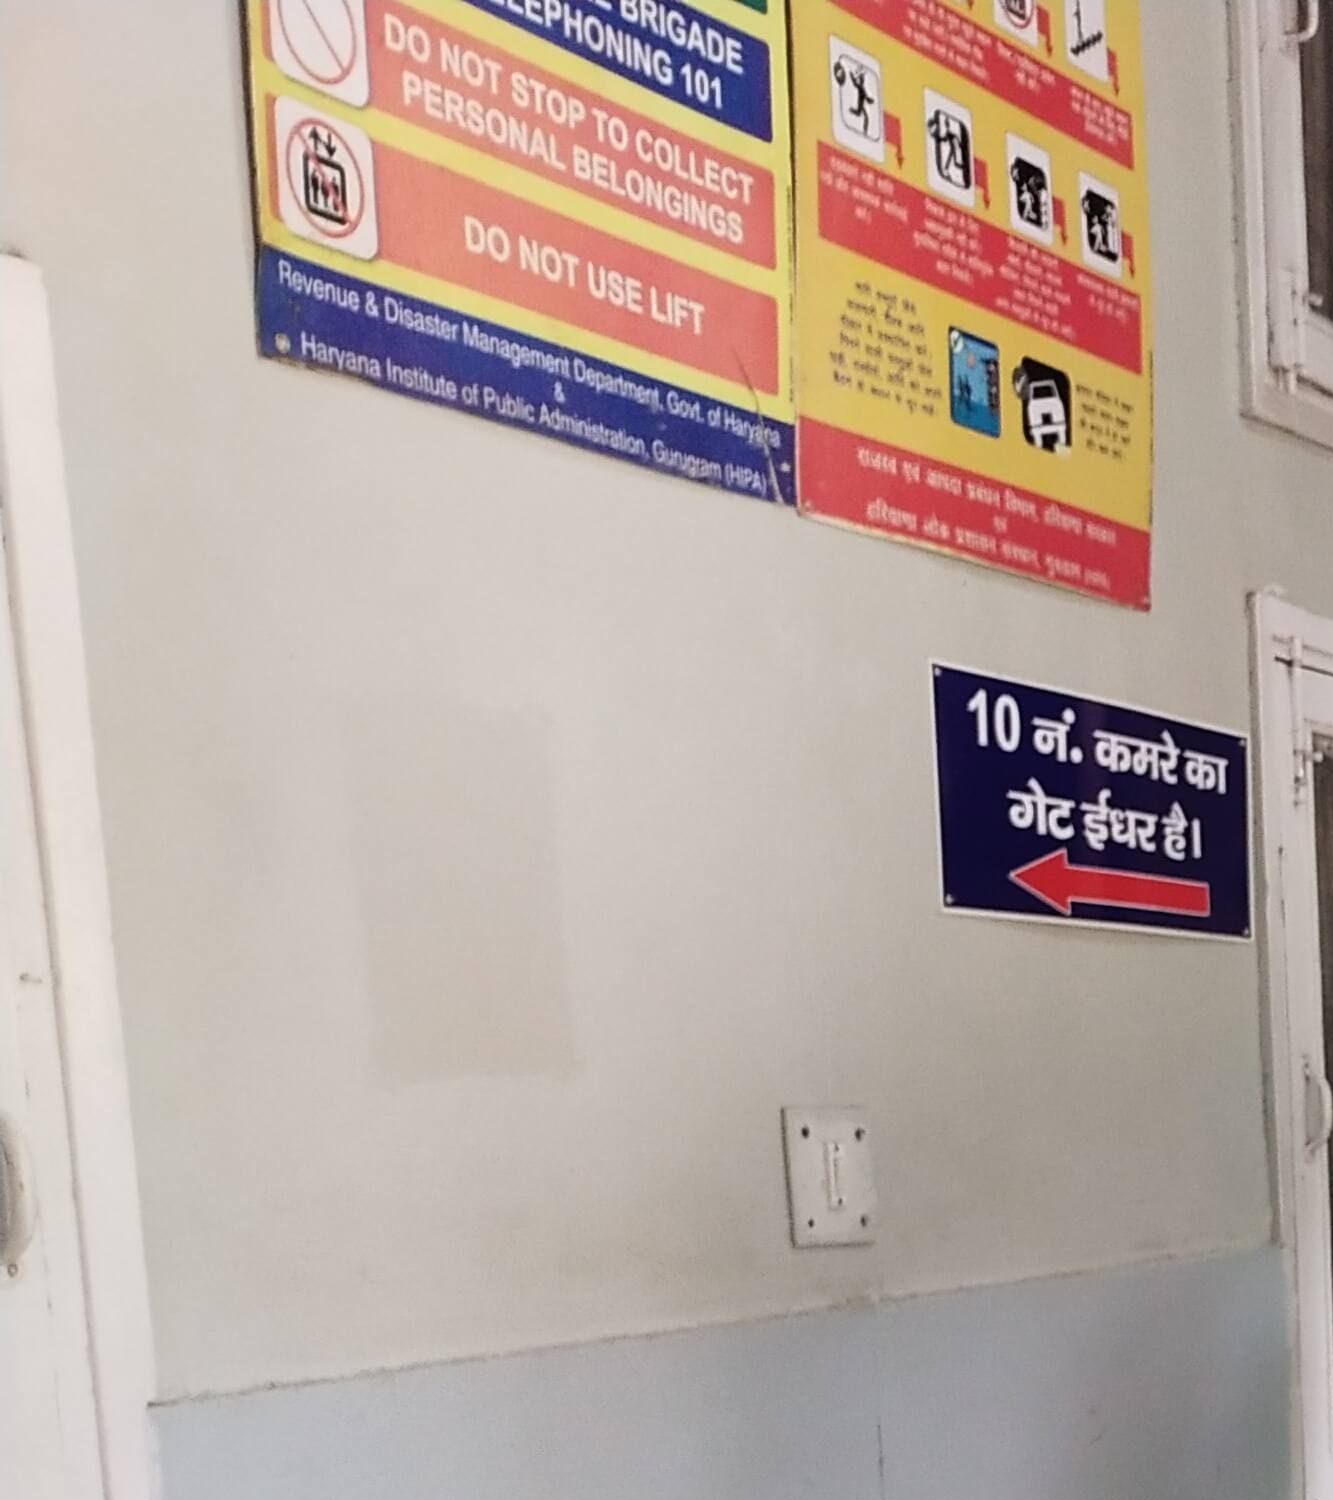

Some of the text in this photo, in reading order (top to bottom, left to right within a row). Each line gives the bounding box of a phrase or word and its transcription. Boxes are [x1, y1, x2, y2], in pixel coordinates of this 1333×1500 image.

[620, 0, 744, 75] BRIGADE
[680, 63, 723, 110] 101
[384, 13, 430, 63] DO
[440, 38, 502, 94] NOT
[511, 72, 586, 130] STOP
[591, 107, 629, 152] TO
[635, 129, 754, 205] COLLECT
[402, 69, 567, 171] PERSONAL
[572, 144, 744, 242] BELONGINGS
[463, 215, 705, 337] DO NOT USE LIFT
[278, 259, 782, 450] Revenue & Disaster Management Department, Govt. of Haryana
[553, 381, 566, 404] &
[299, 331, 768, 497] Haryana Institute of Public Administration, Gurugram (HIPA)
[966, 688, 1229, 795] 10 नं. कमरे का
[1006, 777, 1076, 841] गेट
[1080, 788, 1158, 853] ईधर
